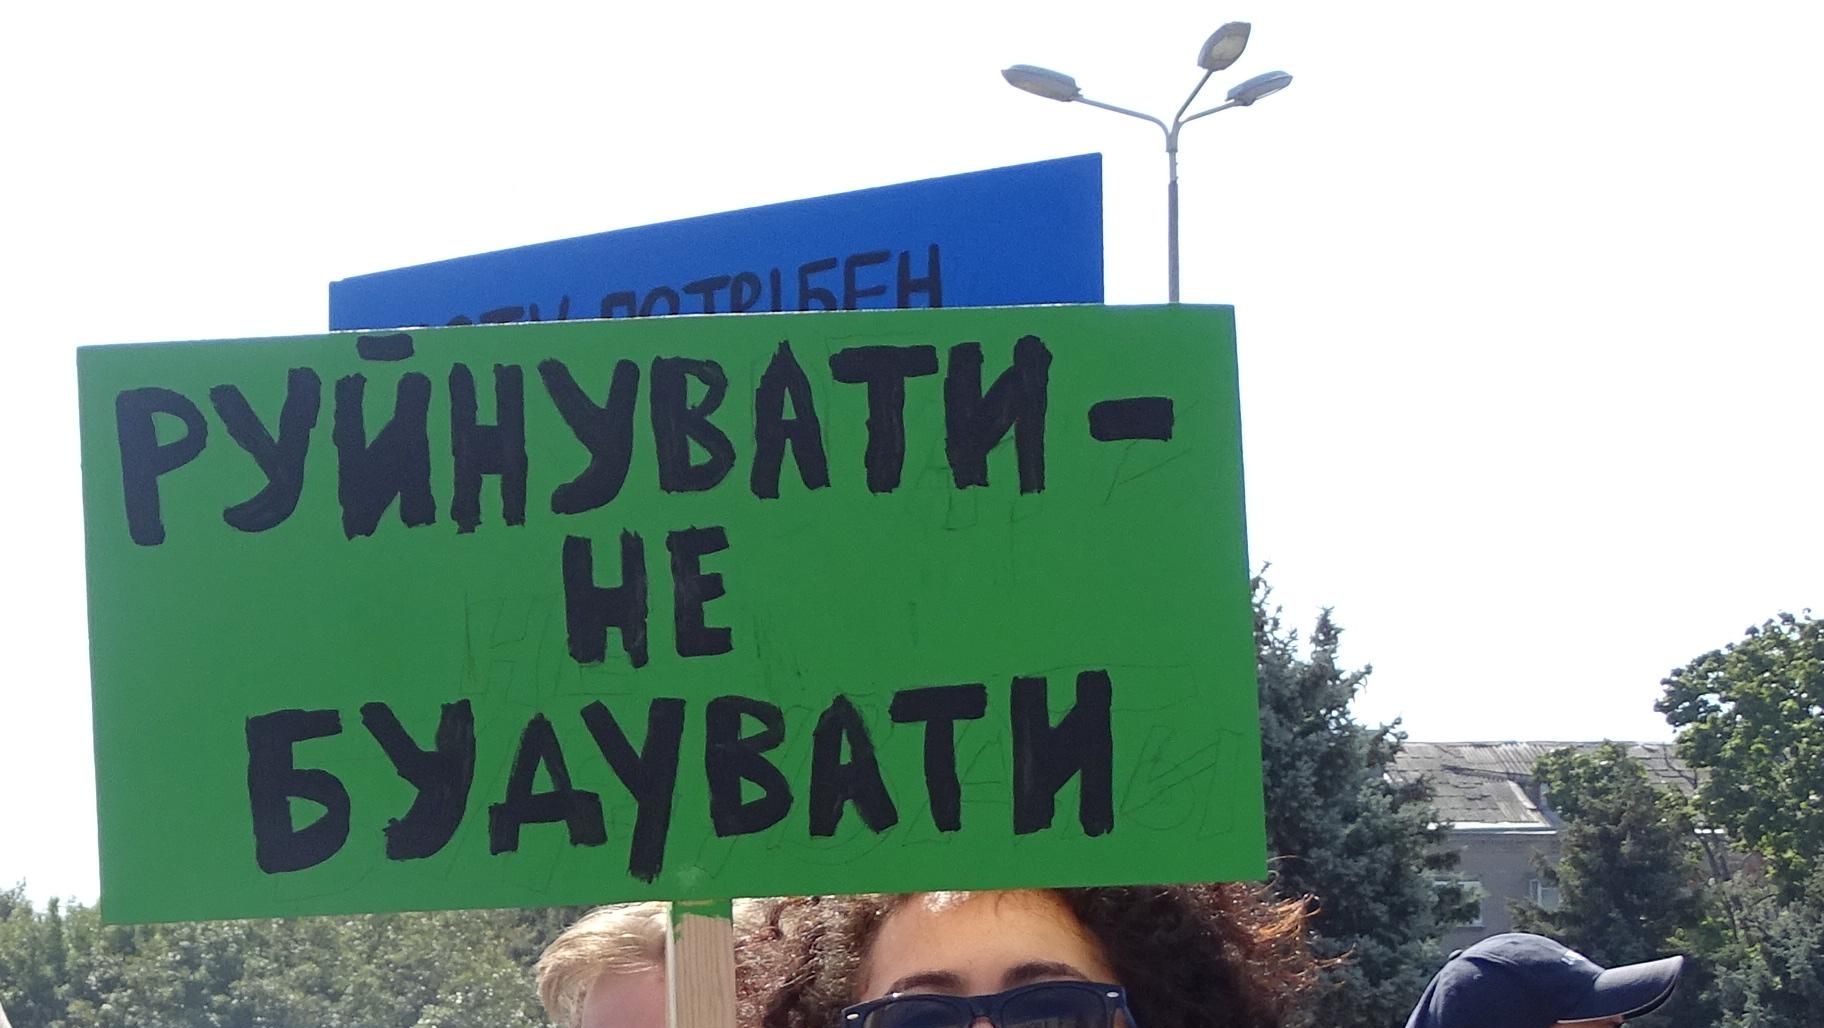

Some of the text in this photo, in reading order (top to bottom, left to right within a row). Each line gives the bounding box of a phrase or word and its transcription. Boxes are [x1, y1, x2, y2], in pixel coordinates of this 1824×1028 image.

[116, 333, 1054, 546] РУЙНУВАТИ
[561, 525, 734, 670] НЕ
[244, 668, 1115, 884] БУДУВАТИ
